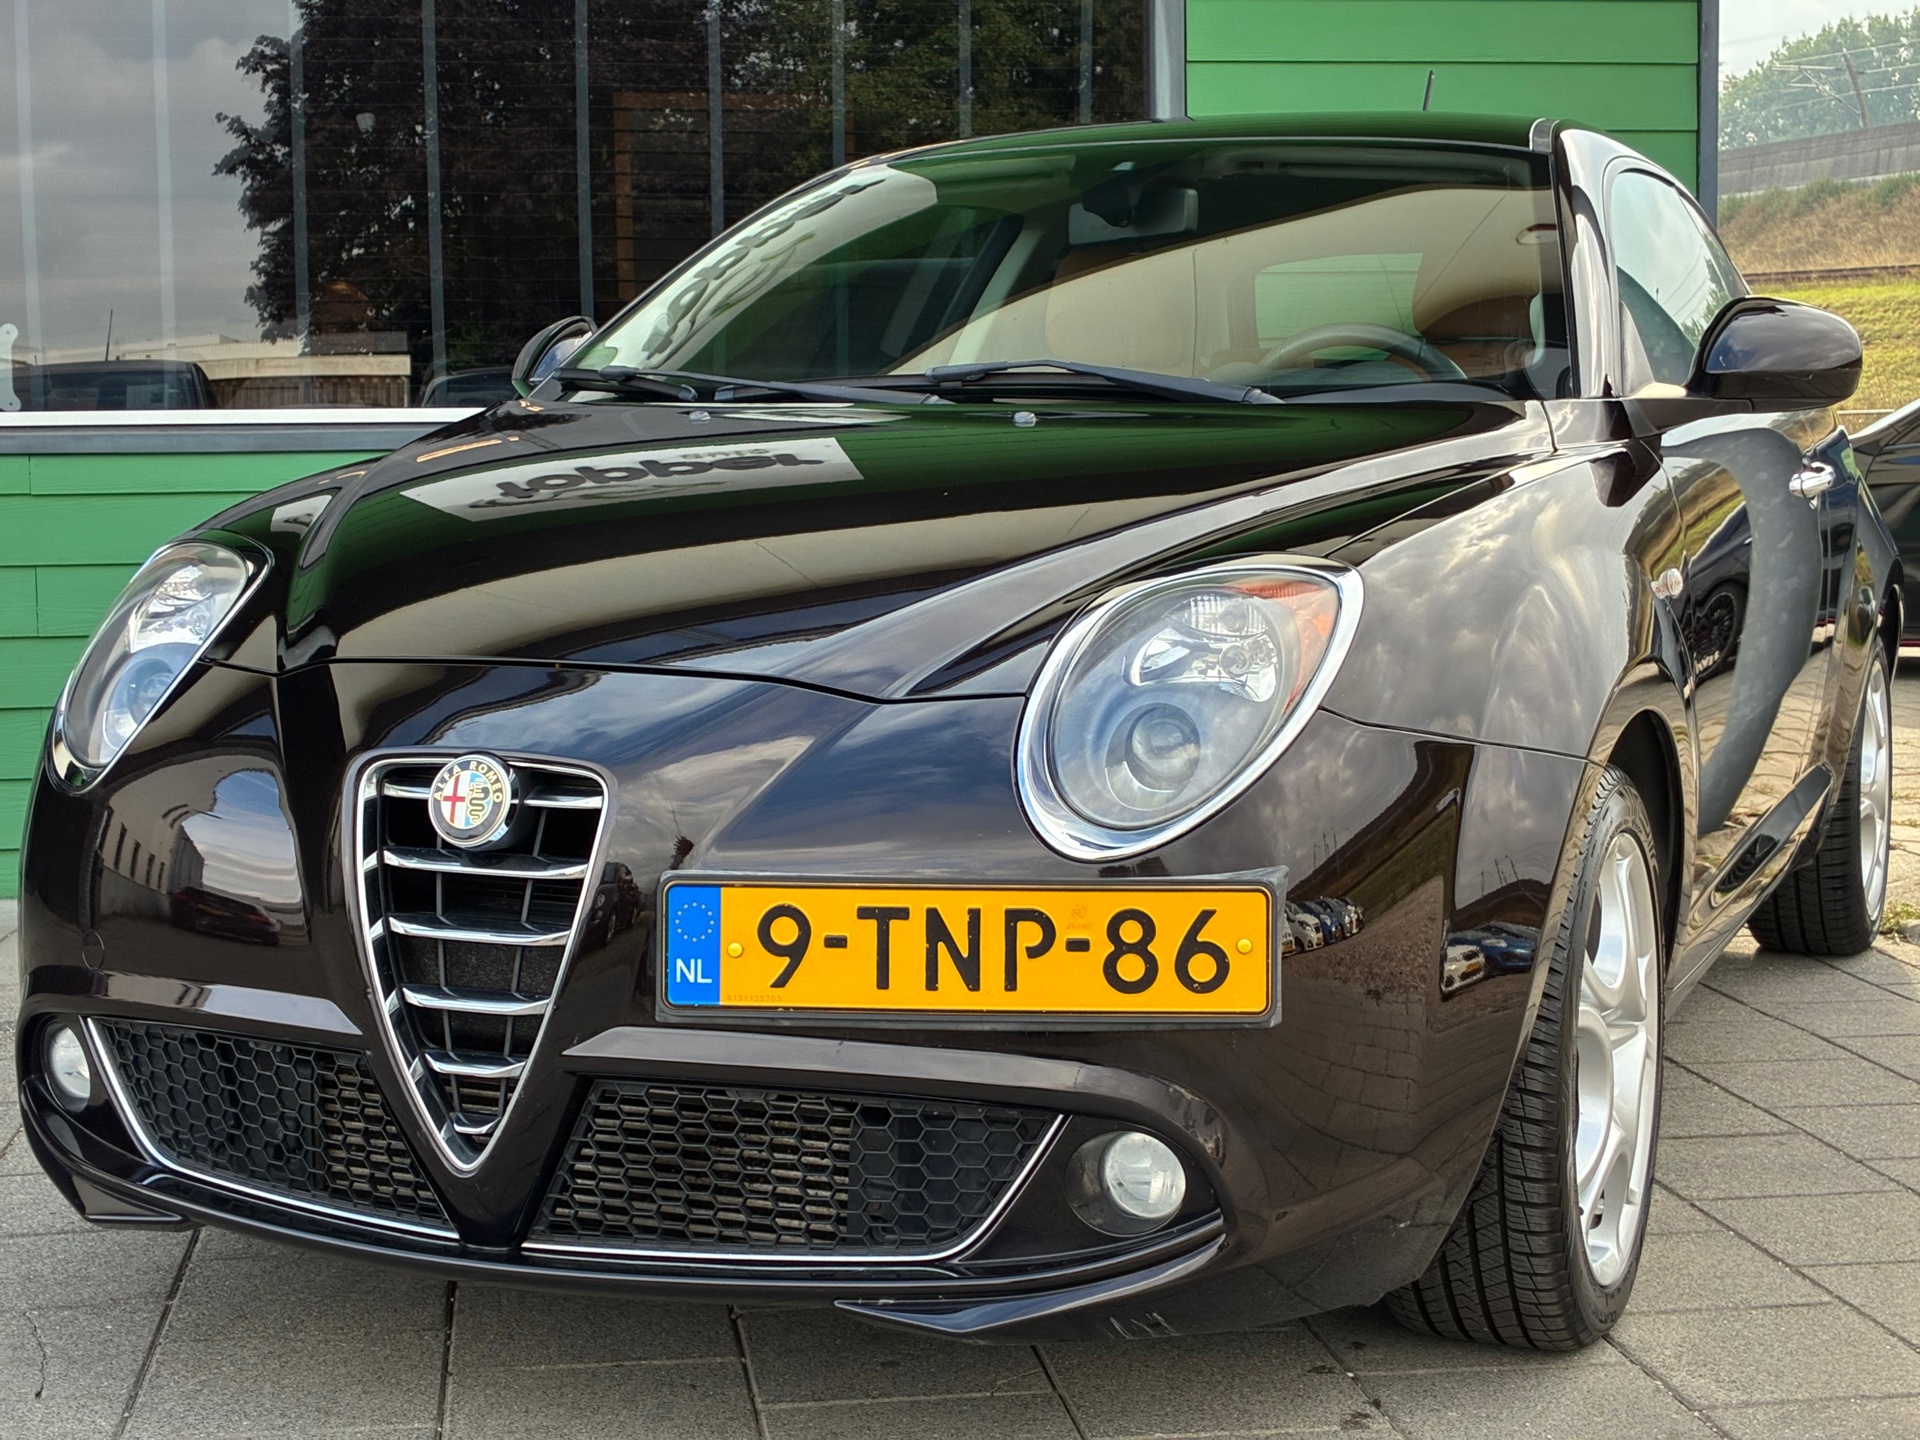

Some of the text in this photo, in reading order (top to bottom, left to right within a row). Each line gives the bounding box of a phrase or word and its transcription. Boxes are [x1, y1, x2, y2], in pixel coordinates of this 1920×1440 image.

[433, 760, 503, 803] ALFA ROMEO
[757, 903, 1231, 994] 9-TNP-86
[675, 958, 713, 984] NL
